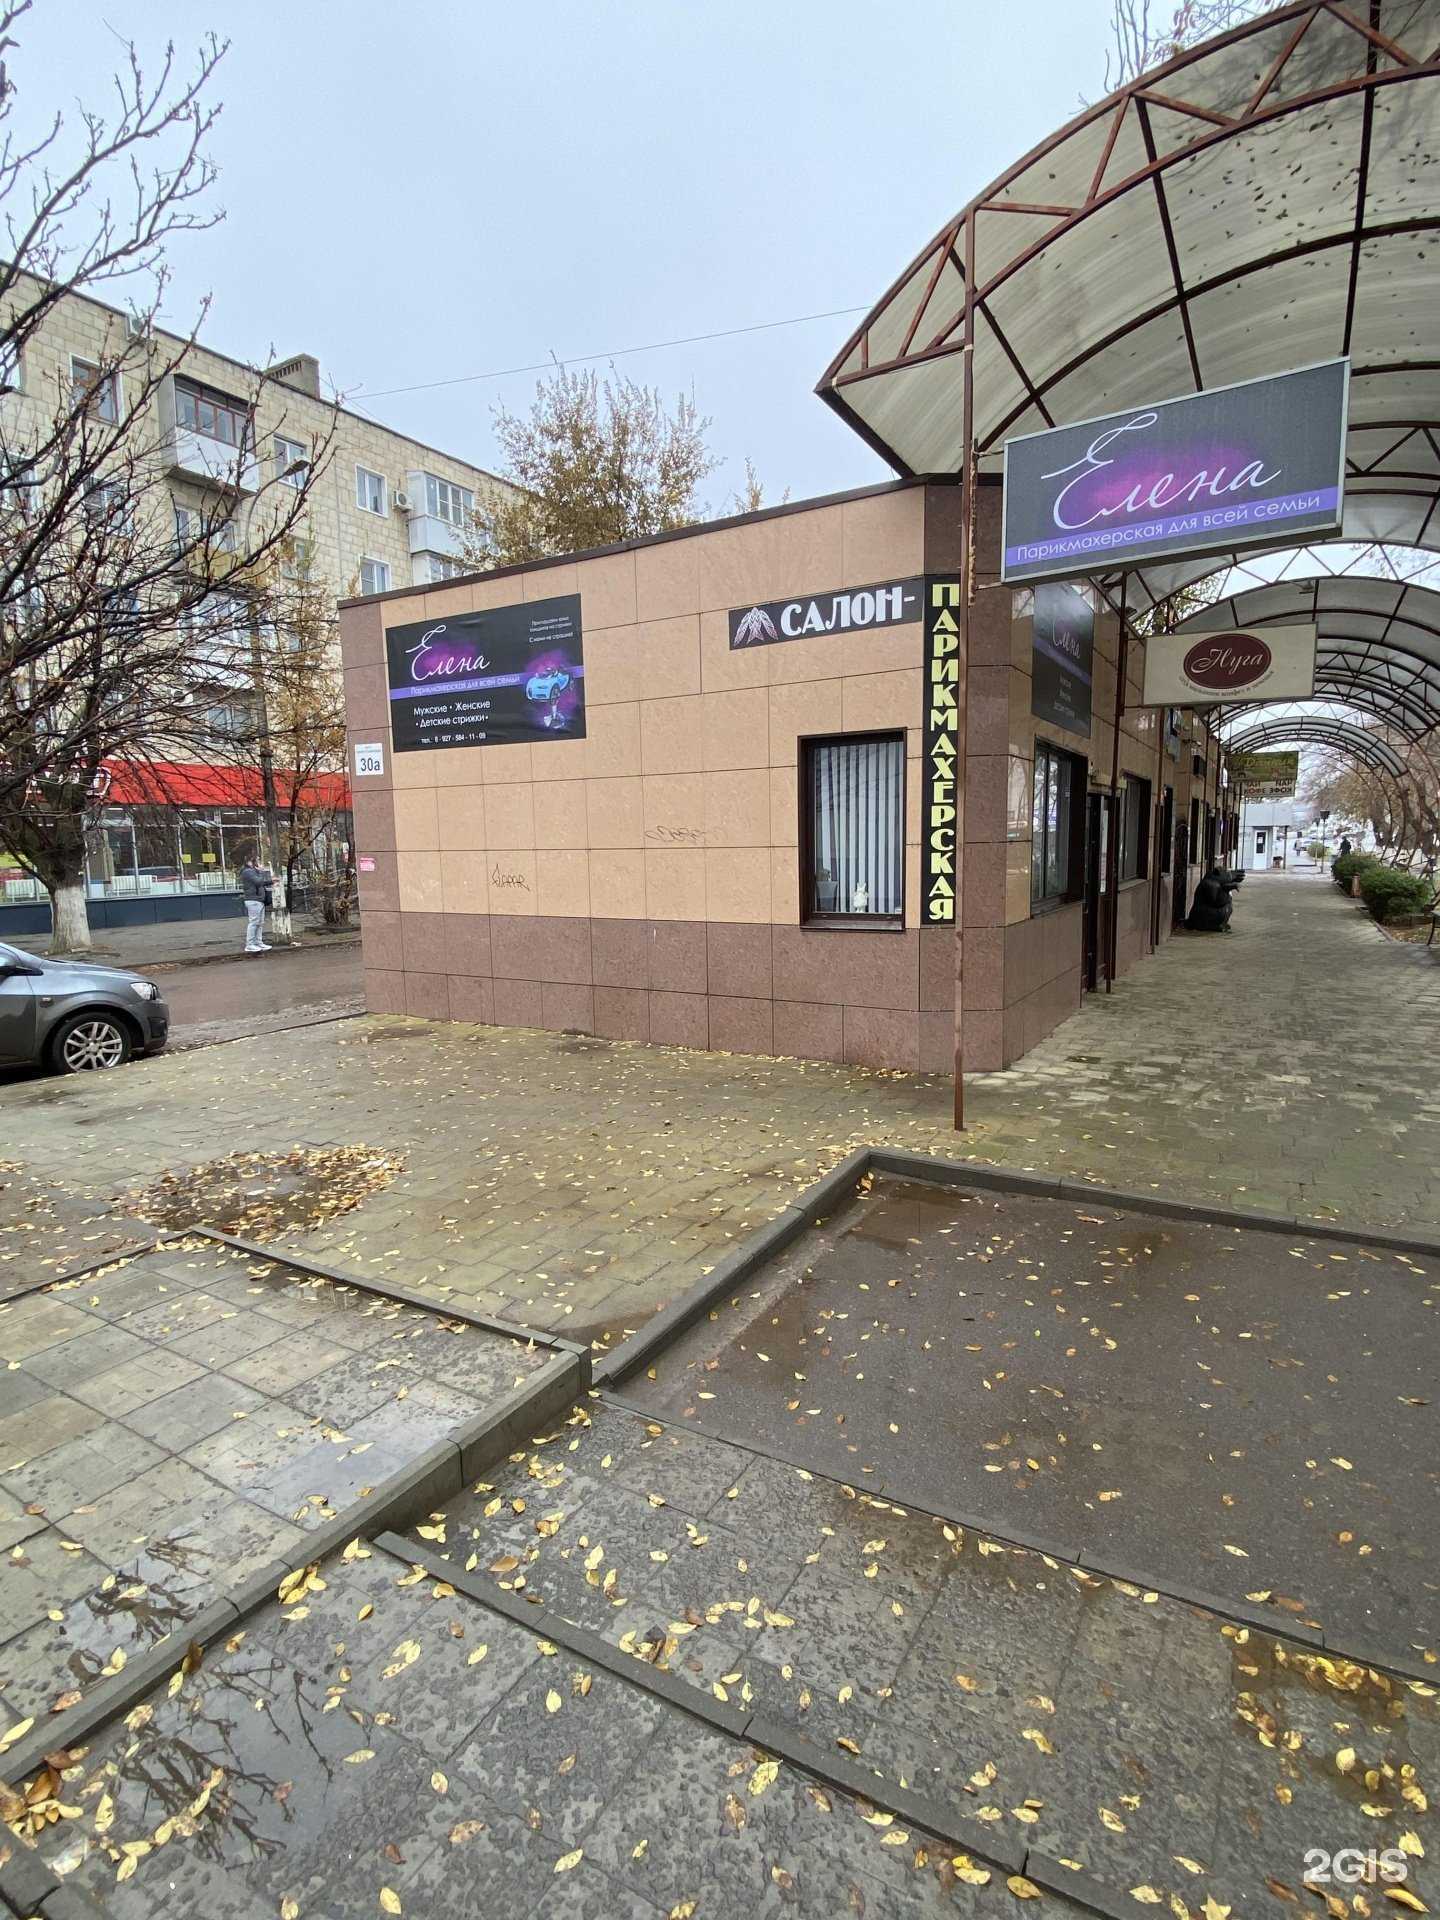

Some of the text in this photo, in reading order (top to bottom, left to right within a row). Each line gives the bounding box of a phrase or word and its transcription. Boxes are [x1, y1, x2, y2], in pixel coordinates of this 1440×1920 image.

[1041, 412, 1281, 530] Елена
[1016, 494, 1320, 562] Парикмахерская для всей семьи
[405, 624, 490, 681] Елена
[1190, 647, 1264, 676] Нуга
[410, 680, 466, 696] Парикмахерская
[413, 700, 491, 717] Мужские Женские
[419, 714, 485, 729] Детские стрижки
[360, 757, 381, 772] 30а
[929, 583, 960, 920] ПАРИКМАХЕРСКАЯ
